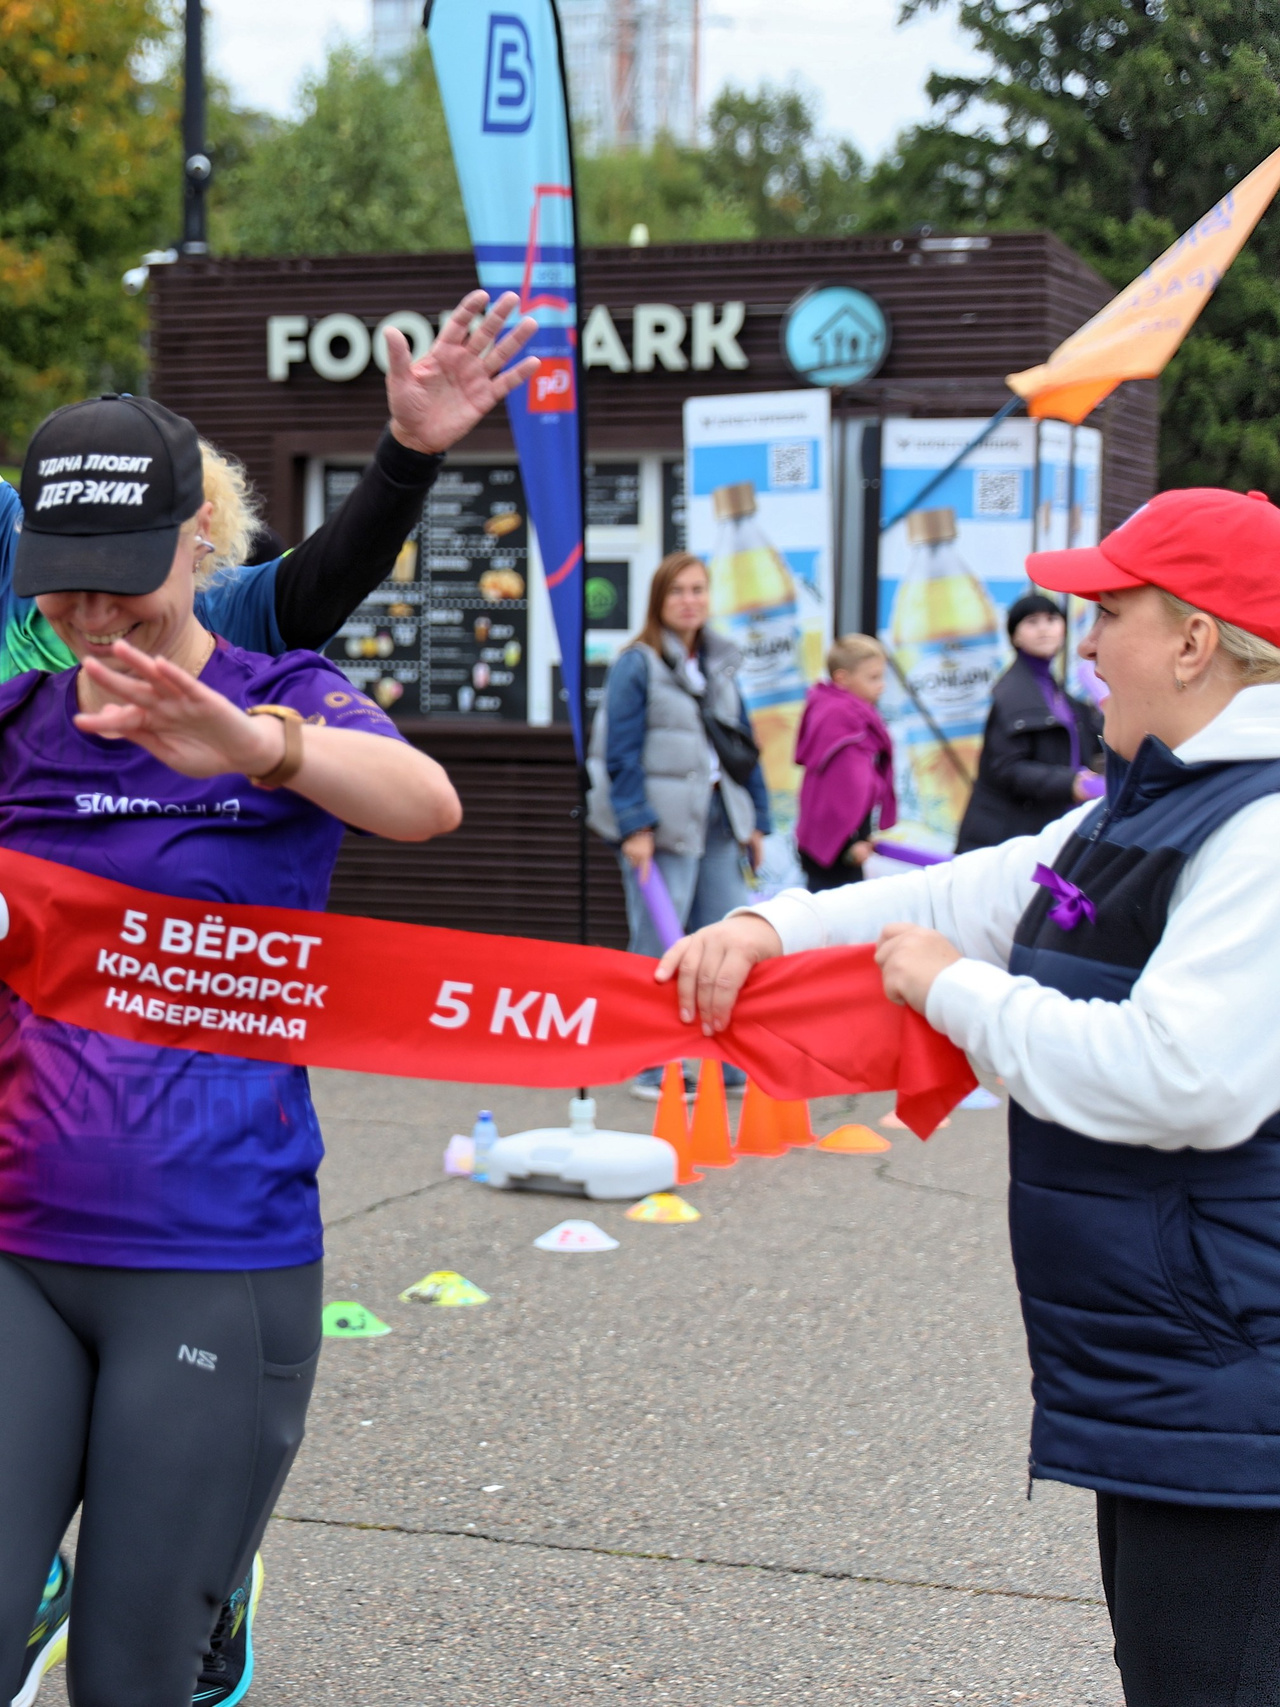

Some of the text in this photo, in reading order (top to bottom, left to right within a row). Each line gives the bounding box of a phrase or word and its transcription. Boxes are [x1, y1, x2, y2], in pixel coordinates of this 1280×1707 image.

[266, 301, 749, 383] FOO ARK
[38, 453, 153, 477] УДАЧА ЛЮБИТ
[35, 480, 150, 511] ДЕРЗКИХ
[120, 908, 322, 970] 5 ВЁРСТ
[96, 948, 328, 1008] КРАСНОЯРСК
[104, 987, 307, 1041] НАБЕРЕЖНАЯ
[428, 979, 598, 1046] 5 КМ
